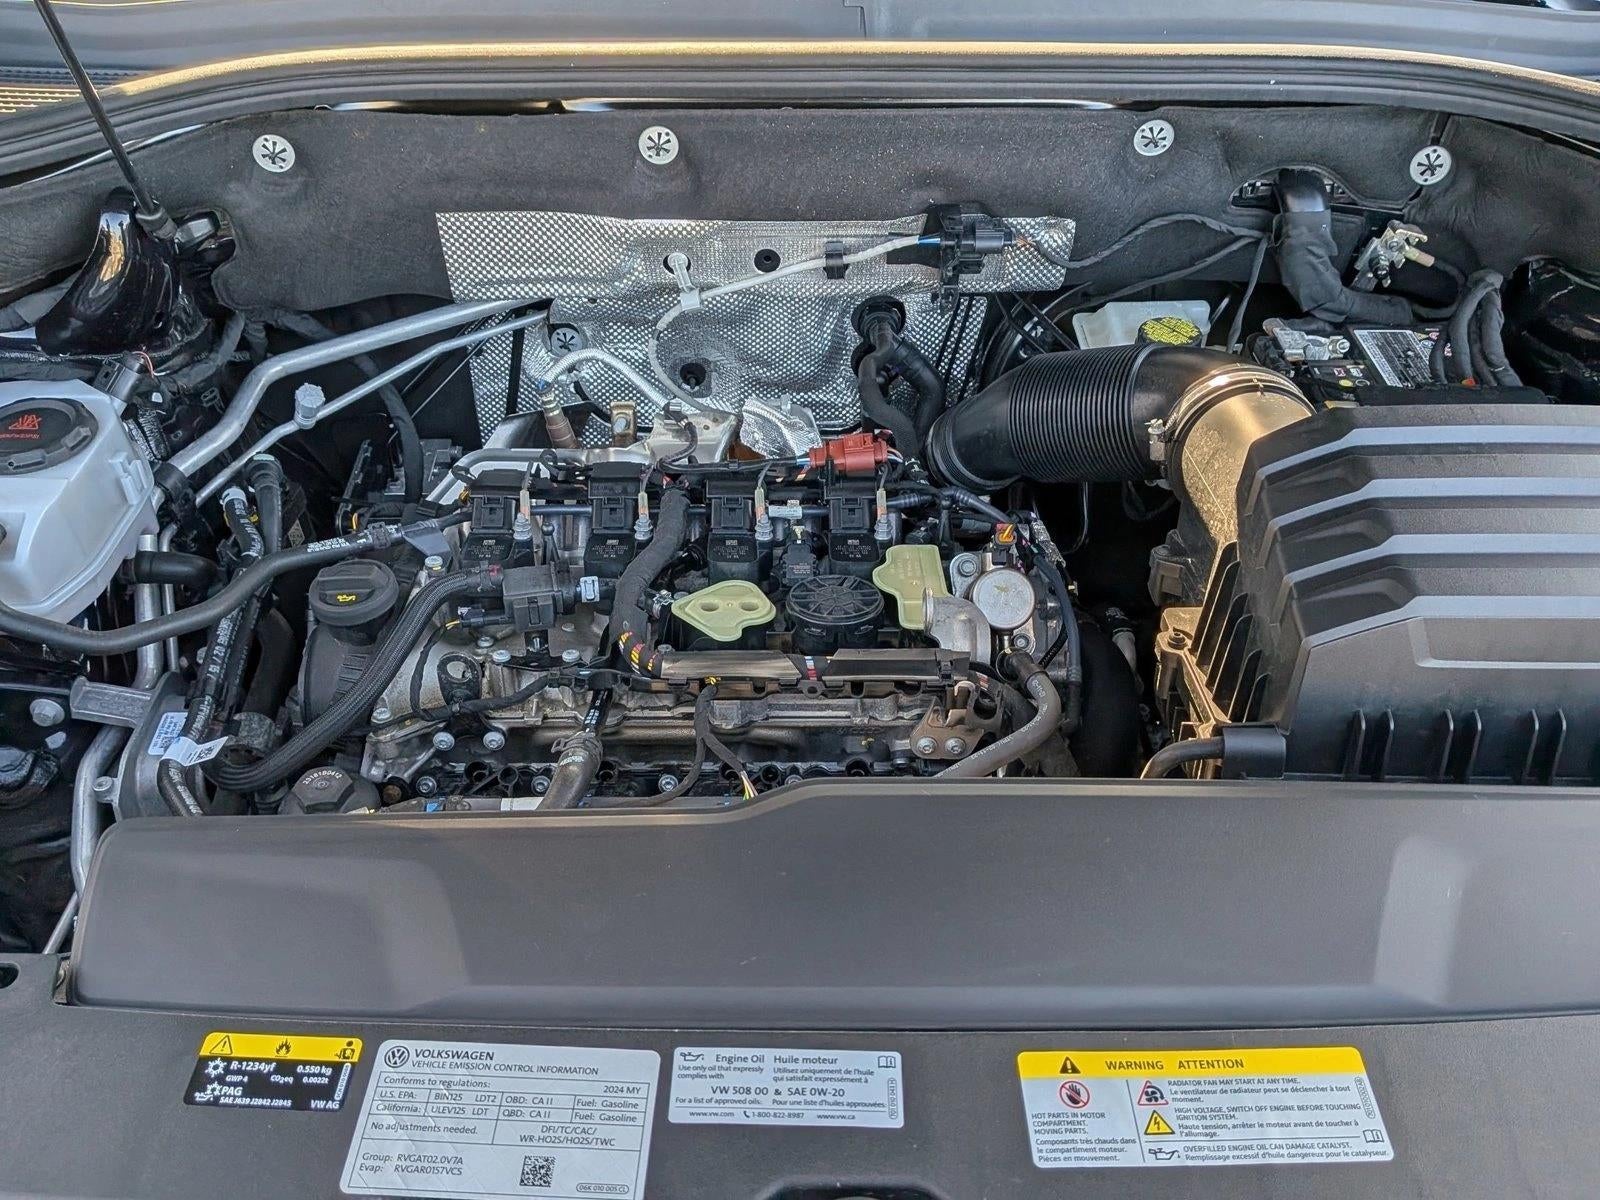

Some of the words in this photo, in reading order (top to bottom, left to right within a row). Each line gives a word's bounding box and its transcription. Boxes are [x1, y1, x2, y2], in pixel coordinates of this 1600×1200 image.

[415, 1048, 494, 1060] VOLKSWAGEN
[716, 1054, 748, 1064] Engine
[750, 1055, 764, 1063] Oil
[774, 1056, 799, 1064] Huile
[802, 1056, 838, 1064] moteur
[230, 1061, 276, 1071] R-1234yf
[297, 1065, 320, 1074] 0.550
[321, 1066, 332, 1075] kg
[412, 1060, 446, 1069] VEHICLE
[448, 1062, 492, 1071] EMISSION
[494, 1064, 534, 1073] CONTROL
[537, 1065, 599, 1076] INFORMATION
[1106, 1060, 1164, 1070] WARNING
[1178, 1058, 1244, 1070] ATTENTION
[384, 1076, 426, 1085] Conforms
[428, 1078, 436, 1086] to
[440, 1078, 491, 1088] regulations:
[603, 1085, 624, 1094] 2024
[626, 1086, 641, 1094] MY
[221, 1086, 242, 1096] PAG
[380, 1090, 396, 1098] U.S.
[398, 1091, 417, 1100] EPA:
[711, 1086, 730, 1094] VW
[732, 1086, 752, 1096] 508
[754, 1087, 768, 1096] 00
[788, 1088, 807, 1096] SAE
[810, 1088, 845, 1098] 0W-20
[434, 1092, 463, 1101] BIN125
[475, 1094, 496, 1103] LDT2
[506, 1096, 528, 1104] OBD:
[271, 1099, 292, 1107] J2845
[310, 1100, 326, 1108] VW
[326, 1100, 340, 1109] AG
[376, 1102, 420, 1112] California:
[576, 1099, 597, 1108] Fuel:
[602, 1100, 639, 1109] Gasoline
[431, 1106, 466, 1114] ULEV125
[472, 1108, 489, 1116] LDT
[502, 1109, 524, 1118] OBD:
[574, 1112, 595, 1121] Fuel:
[599, 1114, 638, 1122] Gasoline
[370, 1122, 384, 1130] No
[385, 1122, 441, 1132] adjustments
[443, 1126, 478, 1134] needed.
[541, 1125, 598, 1135] DFI/TC/CAC/
[520, 1134, 616, 1146] WR-HO2S/HO2S/TWC
[1036, 1138, 1078, 1146] Composants
[1046, 1146, 1096, 1155] compartiment
[362, 1152, 393, 1162] Group:
[1186, 1153, 1230, 1162] Remplissage
[1232, 1152, 1260, 1160] excessif
[1286, 1151, 1324, 1160] dangereux
[360, 1163, 384, 1172] Evap:
